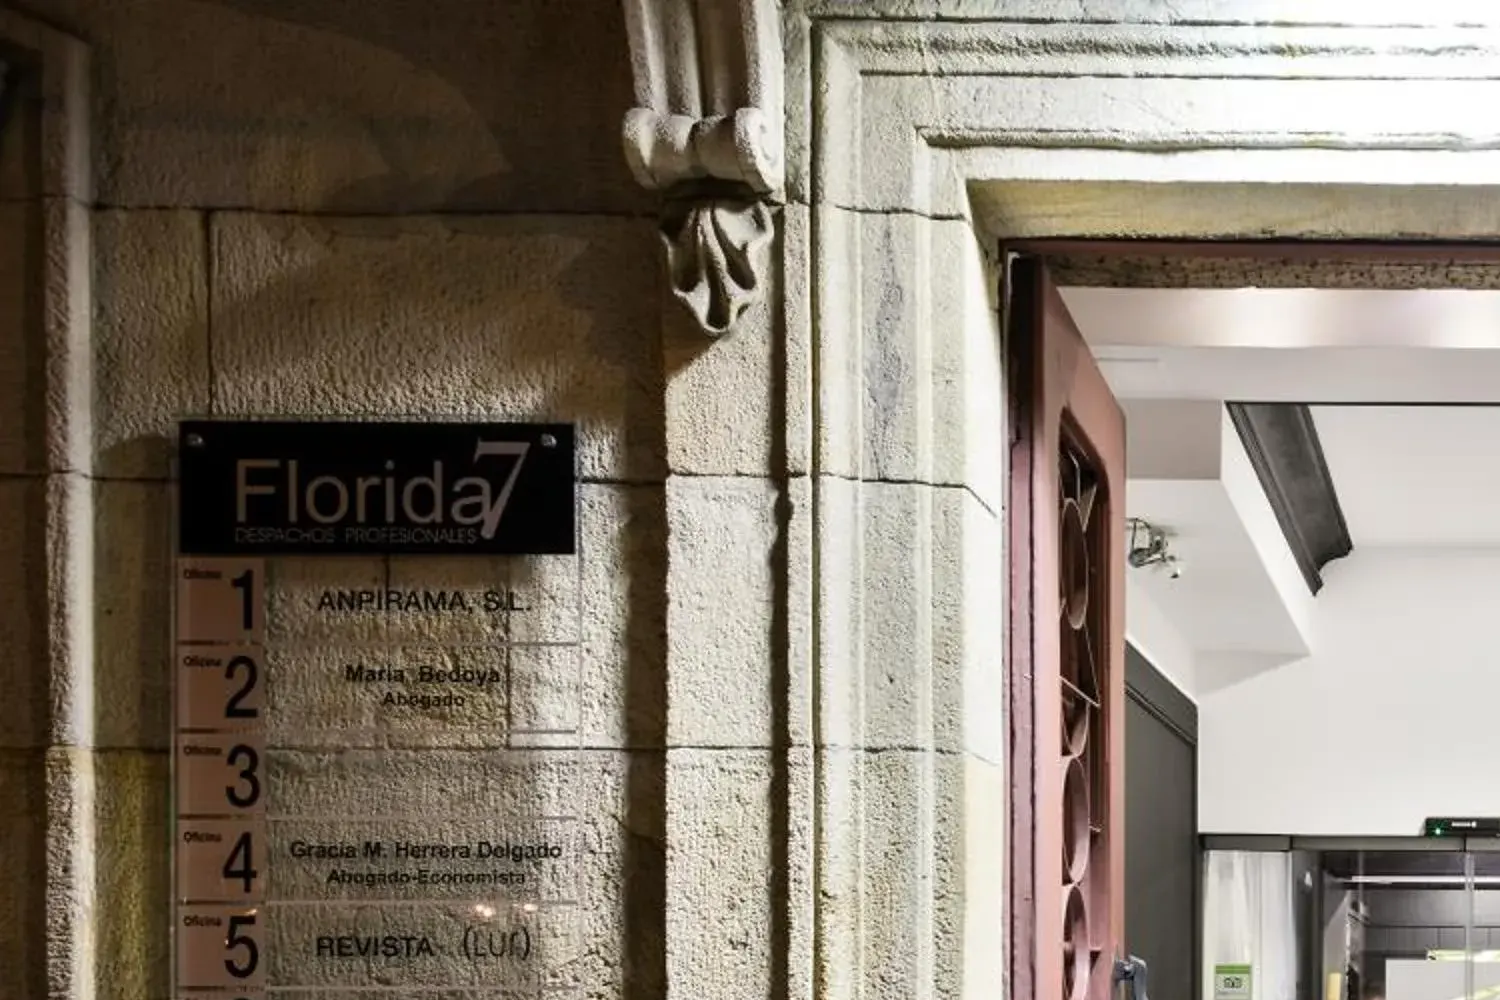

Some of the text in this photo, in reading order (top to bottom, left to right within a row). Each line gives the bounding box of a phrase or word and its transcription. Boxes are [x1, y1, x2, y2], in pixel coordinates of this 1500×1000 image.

[234, 527, 479, 544] DESPACHOS PROFESIONALES
[230, 569, 253, 630] 1
[317, 591, 474, 613] ANPIRAMA,
[224, 656, 258, 718] 2
[419, 664, 501, 687] Bedoya
[382, 691, 465, 709] Abogado
[225, 744, 260, 808] 3
[222, 832, 257, 893] 4
[362, 842, 388, 859] M.
[396, 842, 470, 859] Herrera
[477, 841, 563, 862] Delgado
[225, 915, 259, 979] 5
[316, 936, 435, 957] REVISTA
